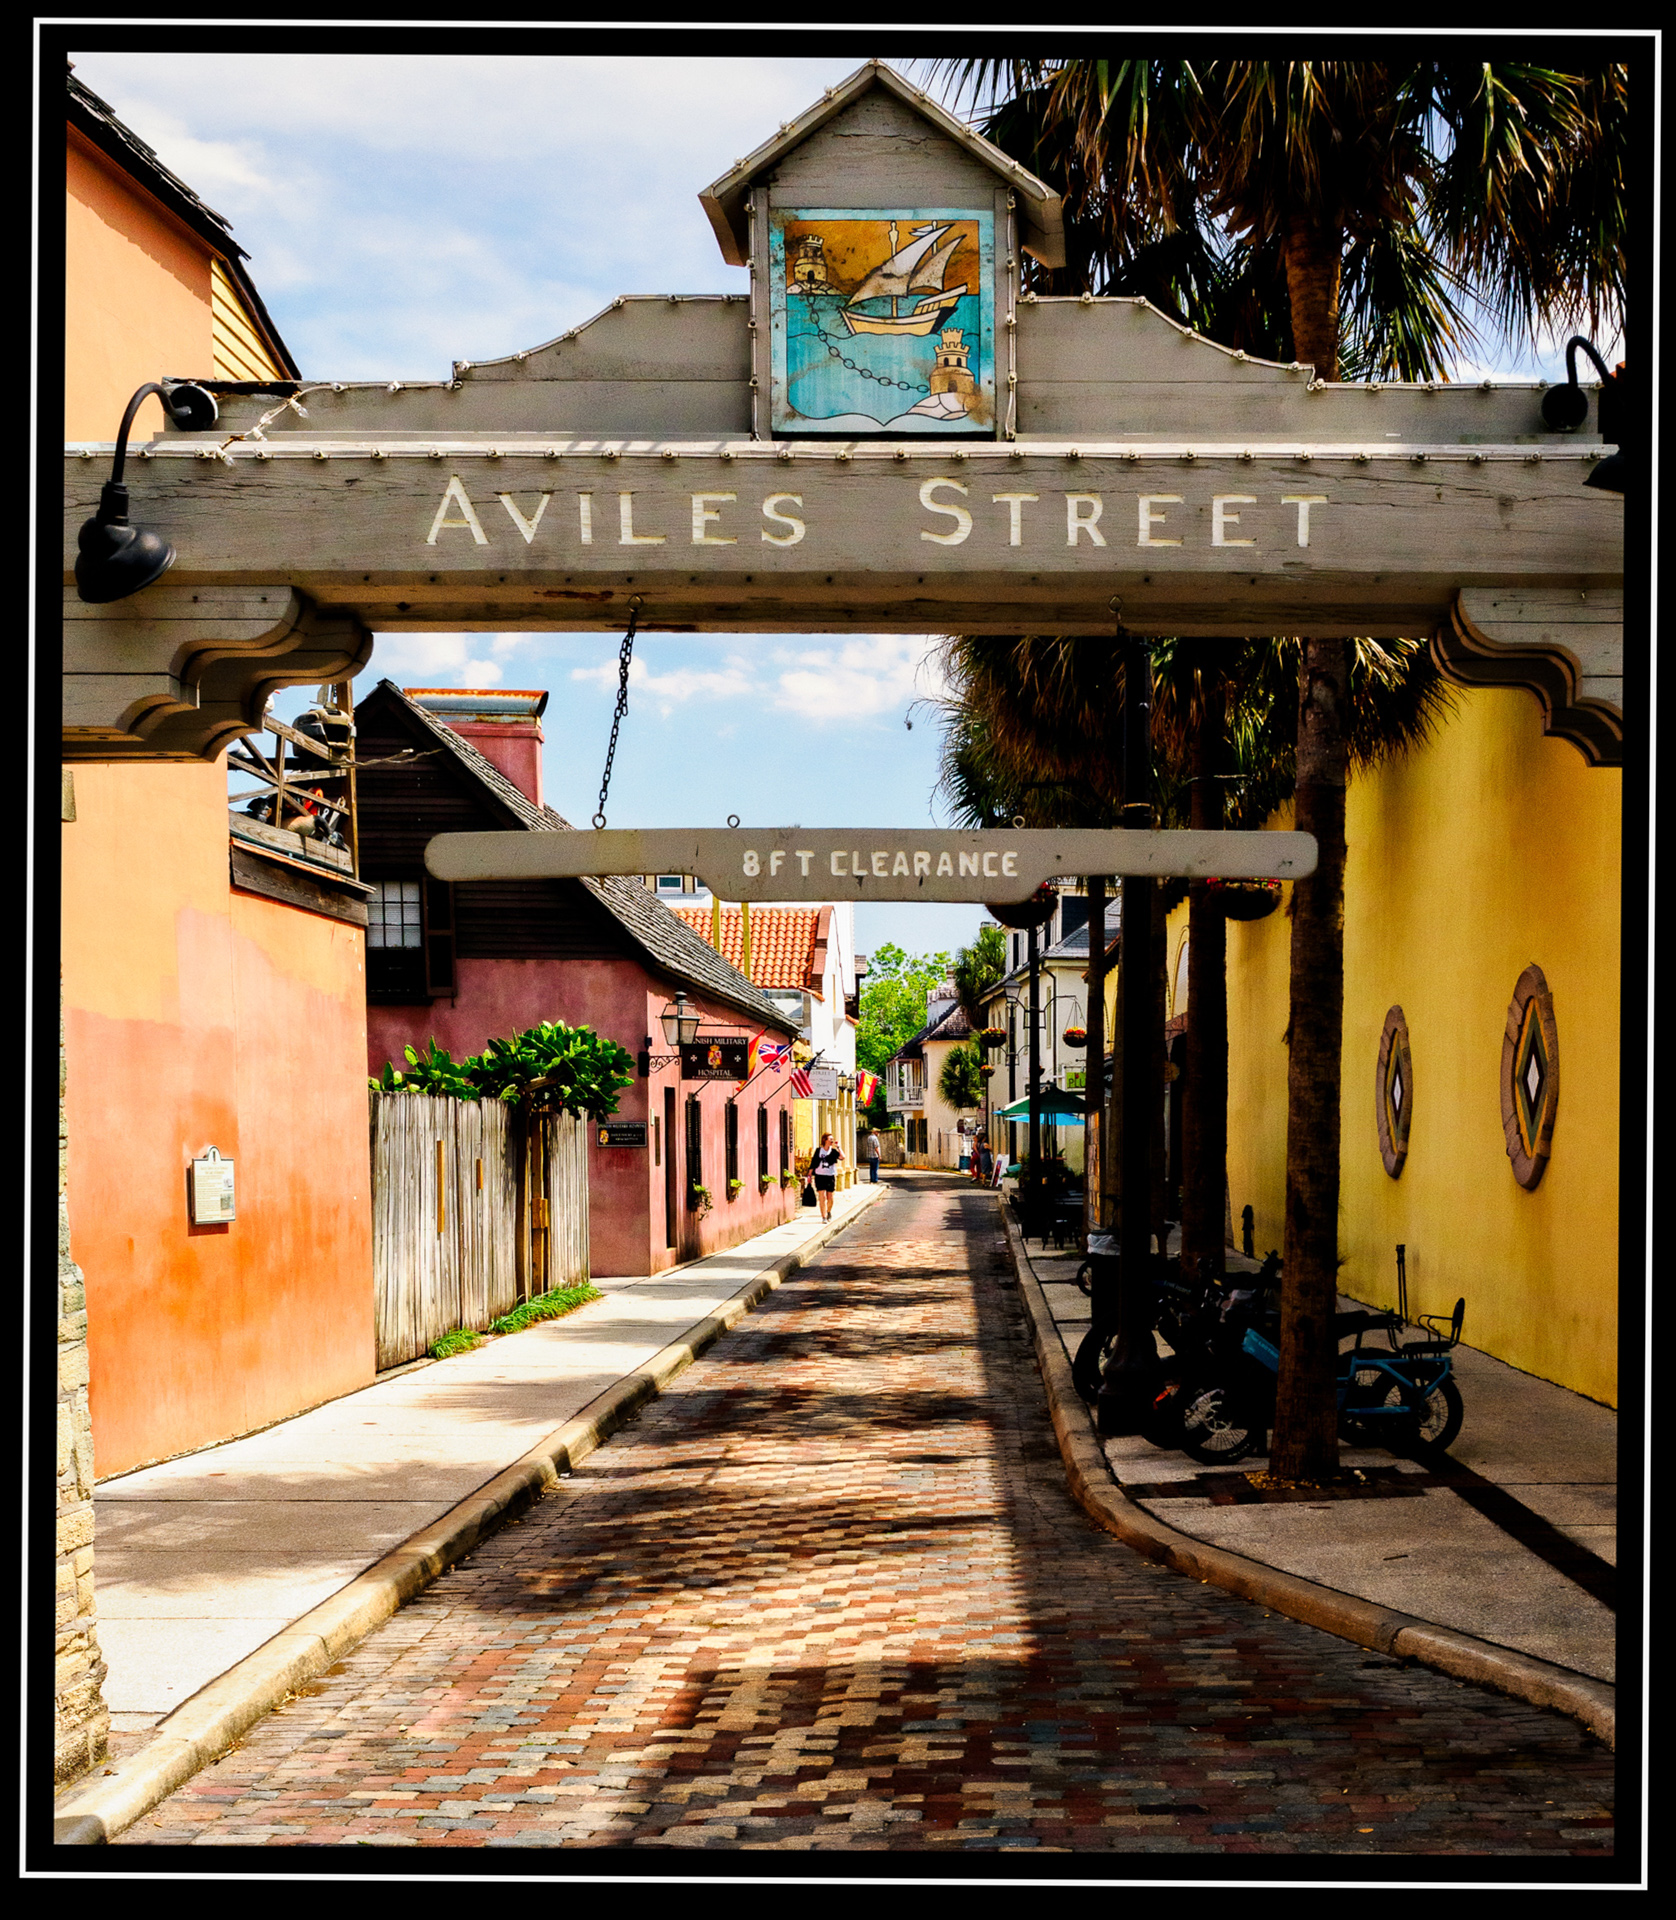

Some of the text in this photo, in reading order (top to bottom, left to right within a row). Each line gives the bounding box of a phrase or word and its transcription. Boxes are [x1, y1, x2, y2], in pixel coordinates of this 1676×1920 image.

[425, 474, 1328, 547] AVILES STREET
[830, 850, 1018, 877] CLEARANCE
[714, 1037, 746, 1045] MILITARY
